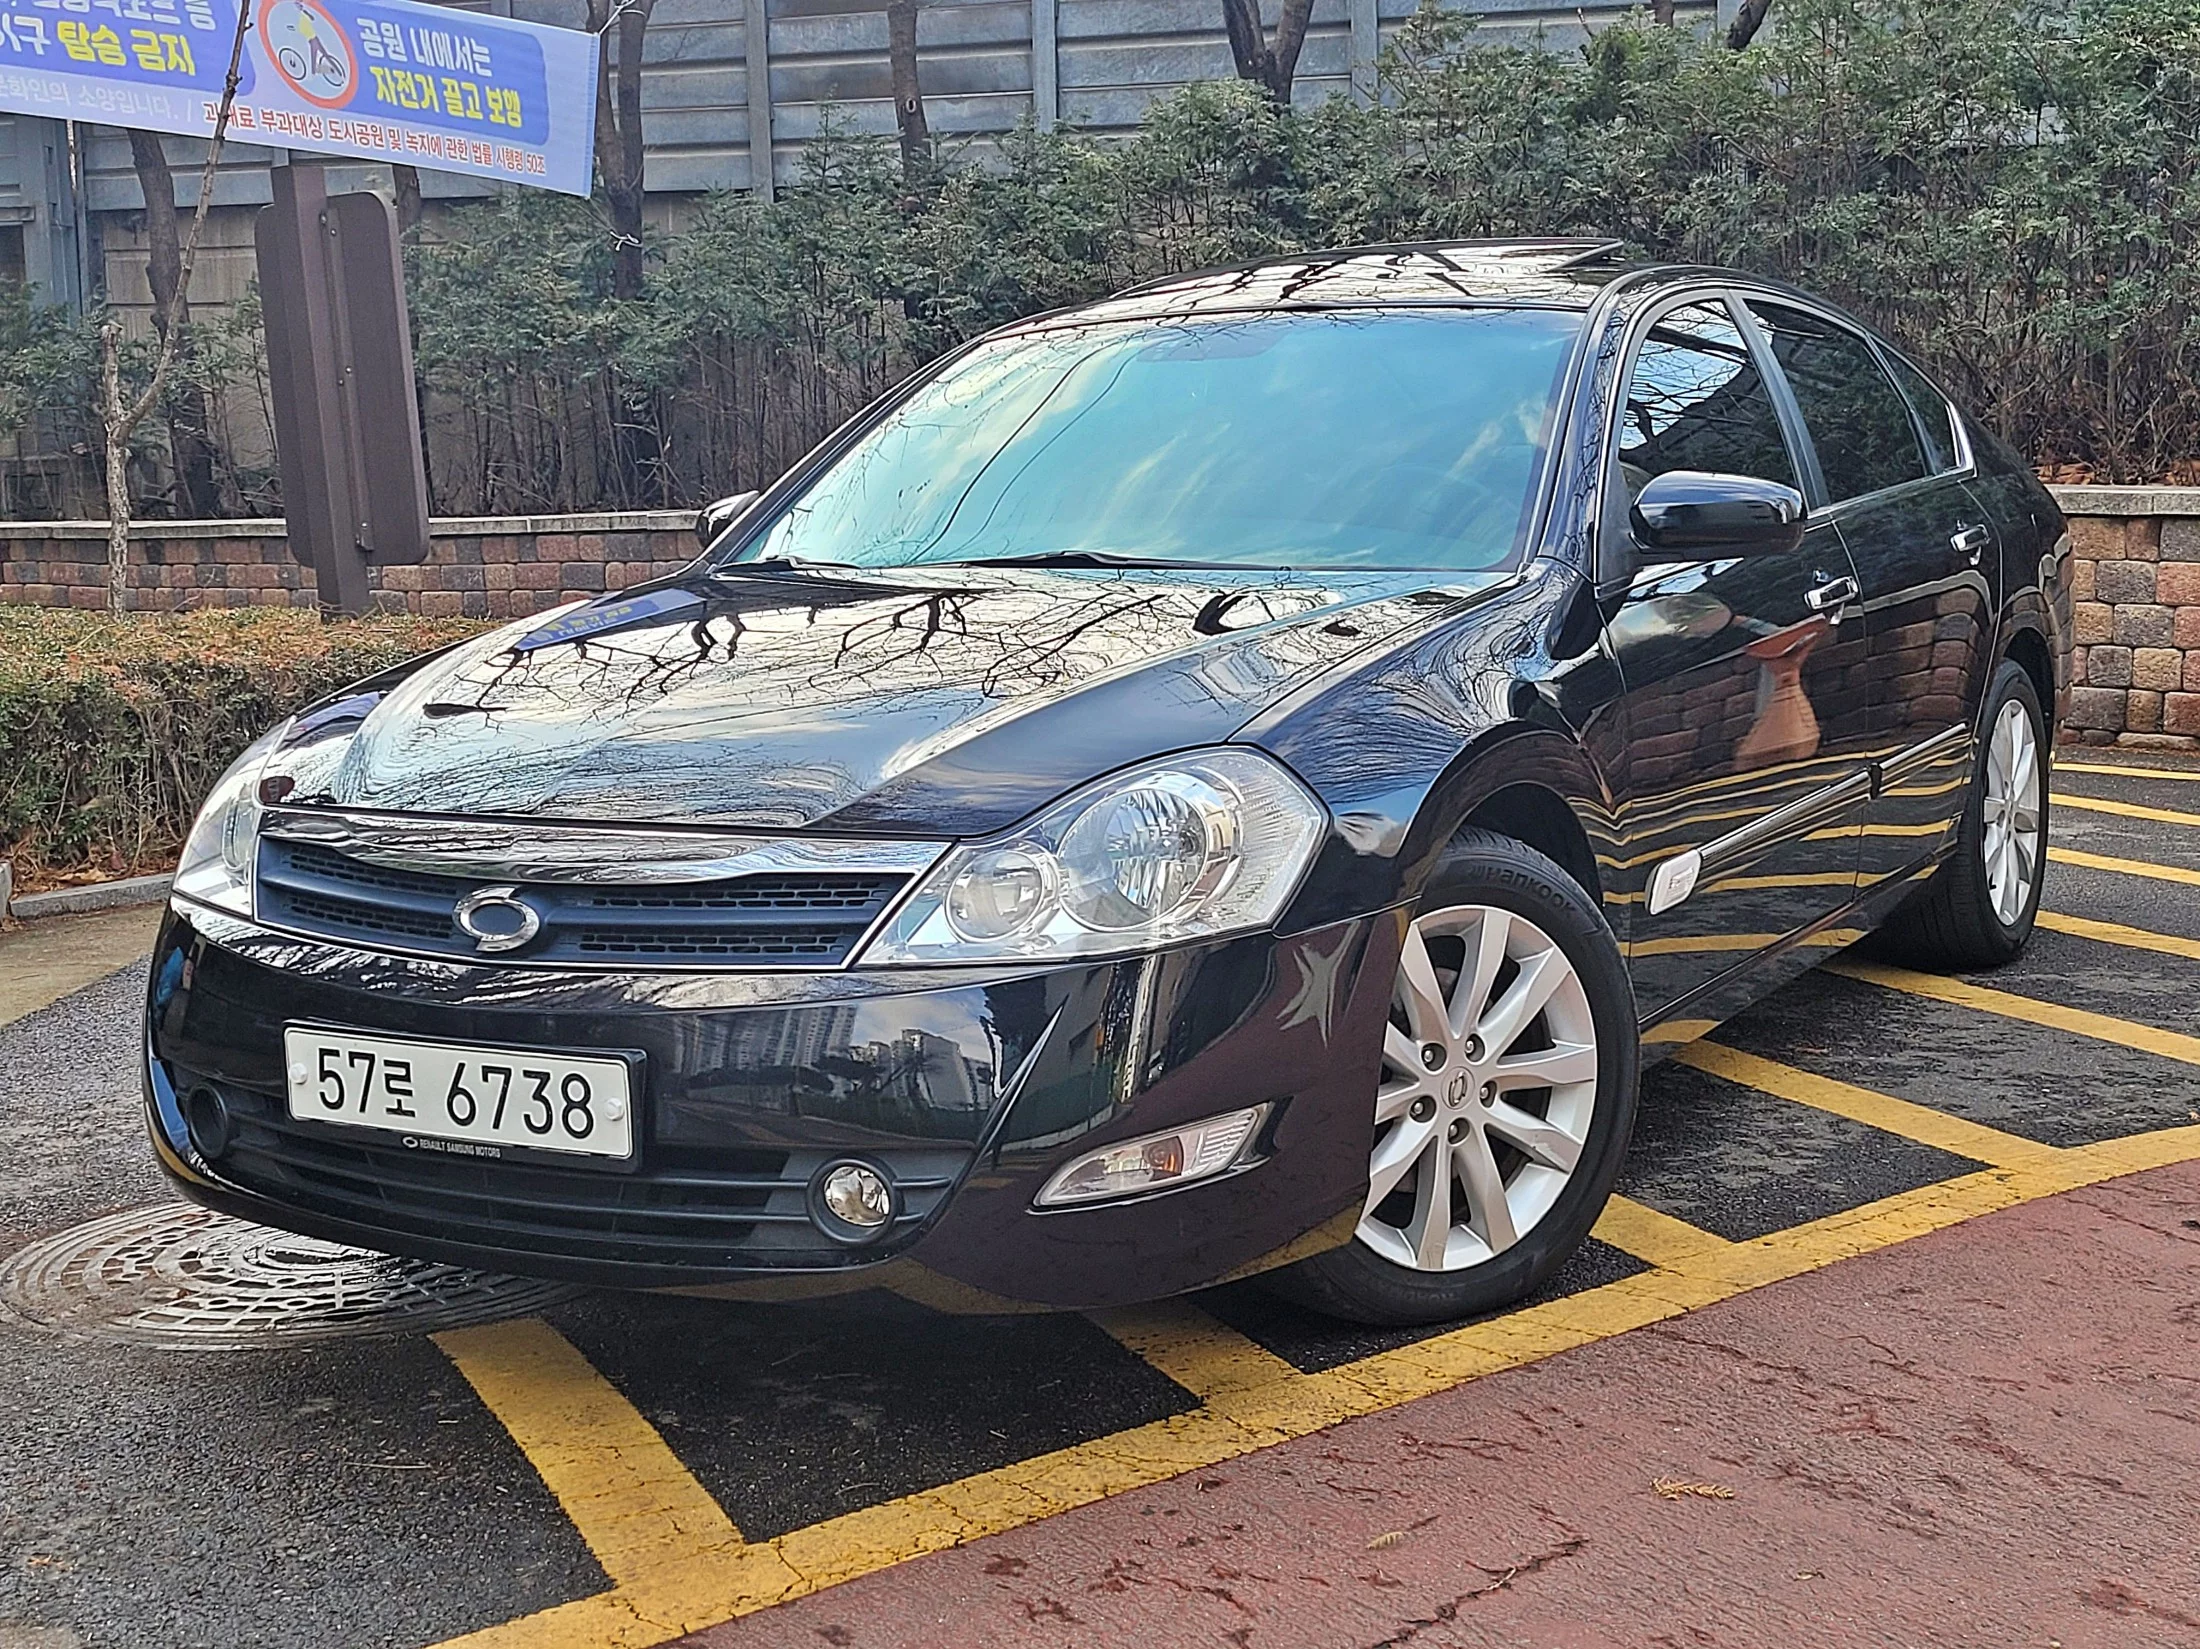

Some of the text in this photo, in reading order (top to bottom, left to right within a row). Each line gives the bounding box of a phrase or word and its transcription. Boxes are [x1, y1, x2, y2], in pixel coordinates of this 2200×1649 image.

[57, 20, 127, 67] 탑승
[130, 28, 196, 77] 금지
[356, 17, 493, 77] 공원 내에서는
[369, 66, 522, 128] 자전거 끌고 보행
[260, 108, 324, 139] 부과대상
[328, 119, 385, 148] 도시공원
[387, 127, 402, 151] 및
[406, 130, 443, 158] 녹지에
[446, 137, 469, 161] 관한
[472, 142, 493, 166] 법률
[496, 146, 523, 172] 시행령
[526, 153, 546, 174] 50조
[318, 1047, 594, 1140] 57로 6738
[419, 1138, 501, 1158] RENAULT SAMSUNG MOTORS
